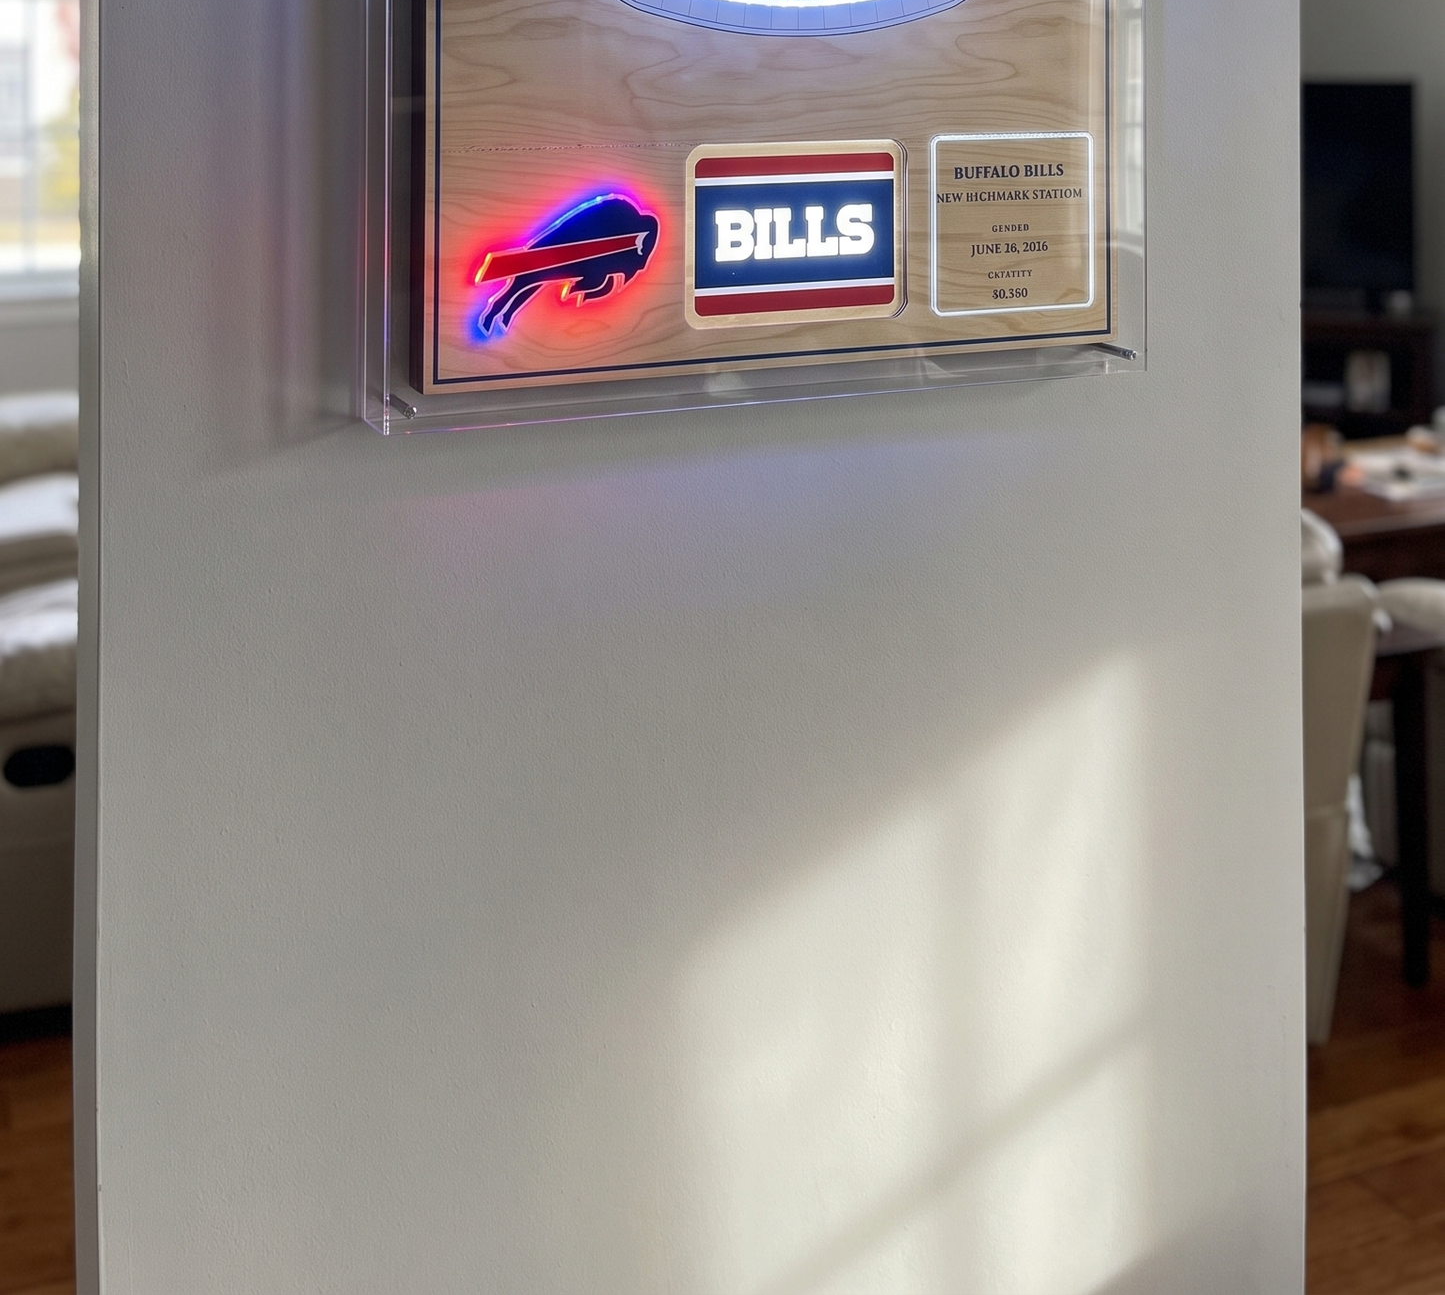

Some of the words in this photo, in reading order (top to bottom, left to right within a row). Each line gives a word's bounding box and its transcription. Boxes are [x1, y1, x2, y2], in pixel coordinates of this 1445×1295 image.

[954, 165, 1020, 180] BUFFALO
[1024, 163, 1064, 178] BILLS
[936, 192, 963, 204] NEW
[714, 203, 875, 263] BILLS
[971, 243, 1002, 257] JUNE
[1022, 241, 1049, 253] 2016
